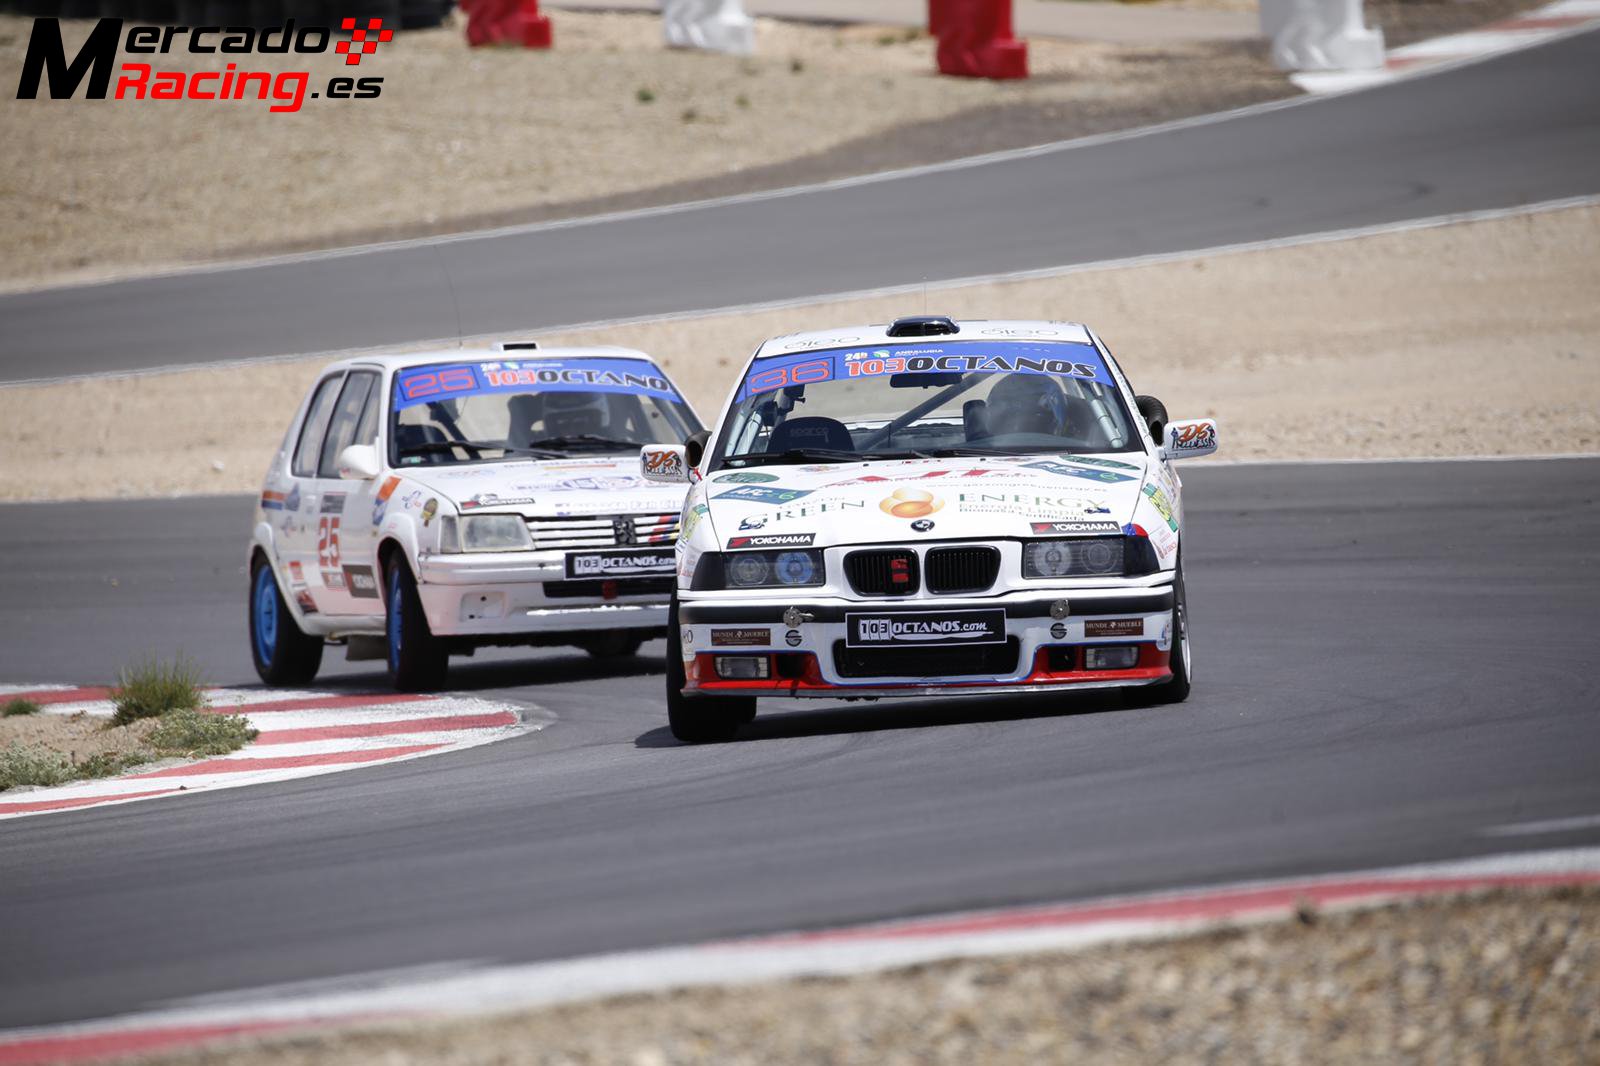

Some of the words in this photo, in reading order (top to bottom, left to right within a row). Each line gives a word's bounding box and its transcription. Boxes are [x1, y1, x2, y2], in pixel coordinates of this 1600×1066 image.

[404, 368, 476, 398] 25
[751, 361, 830, 393] 36
[318, 516, 340, 567] 25
[750, 535, 812, 545] YOKOHAMA
[1052, 522, 1118, 532] YOKOHAMA
